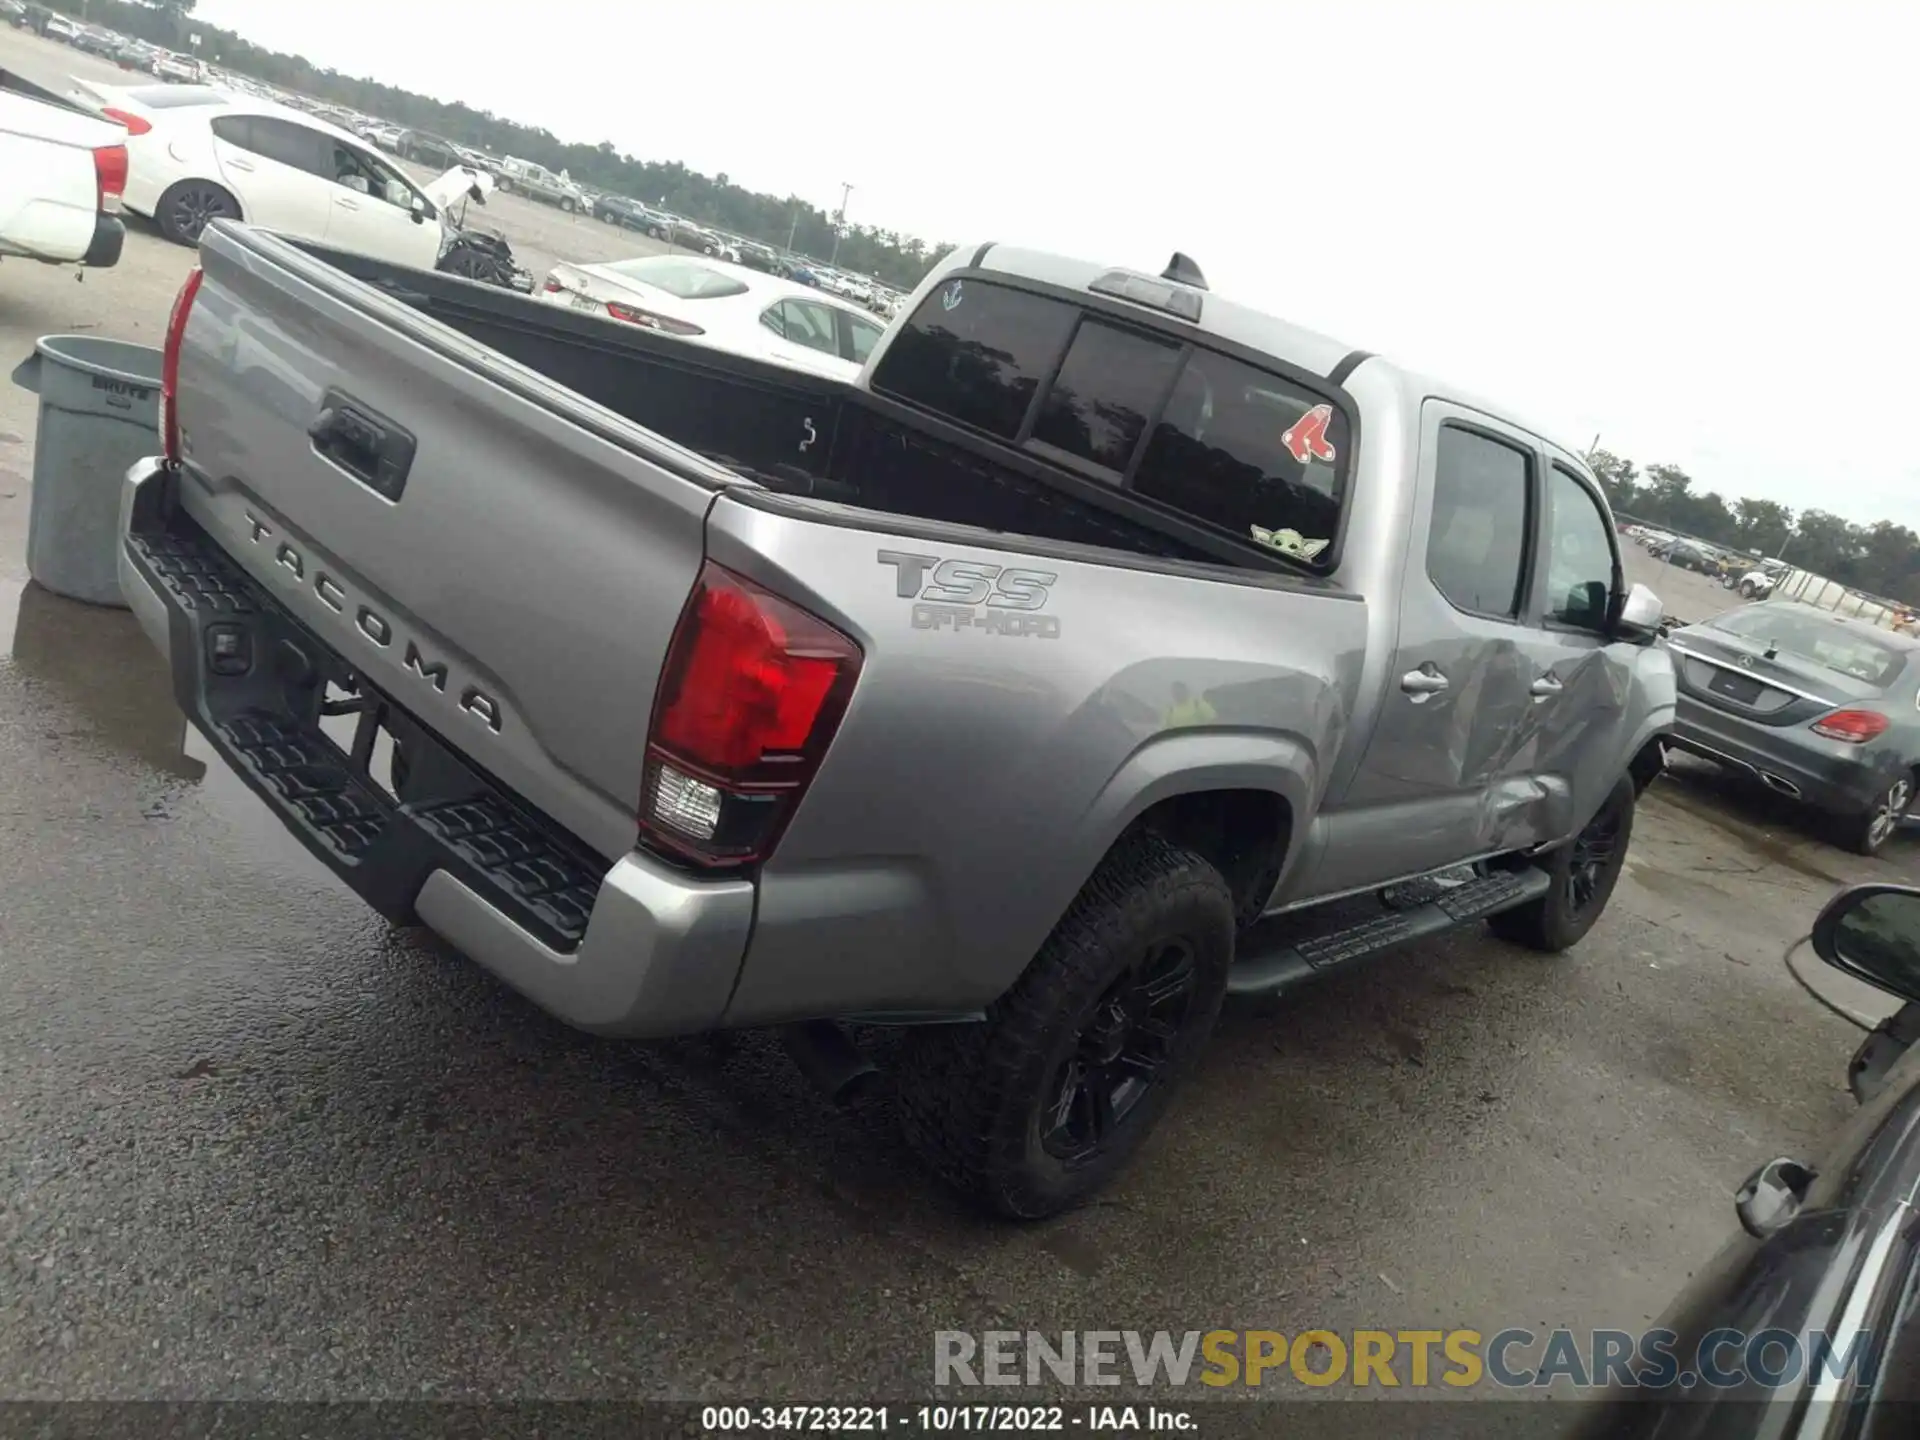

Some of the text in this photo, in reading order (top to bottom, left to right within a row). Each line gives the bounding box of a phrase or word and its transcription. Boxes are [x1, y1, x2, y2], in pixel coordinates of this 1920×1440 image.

[877, 549, 1058, 611] TSS
[244, 508, 503, 736] TACOMA
[911, 602, 1062, 640] OFF-ROAD
